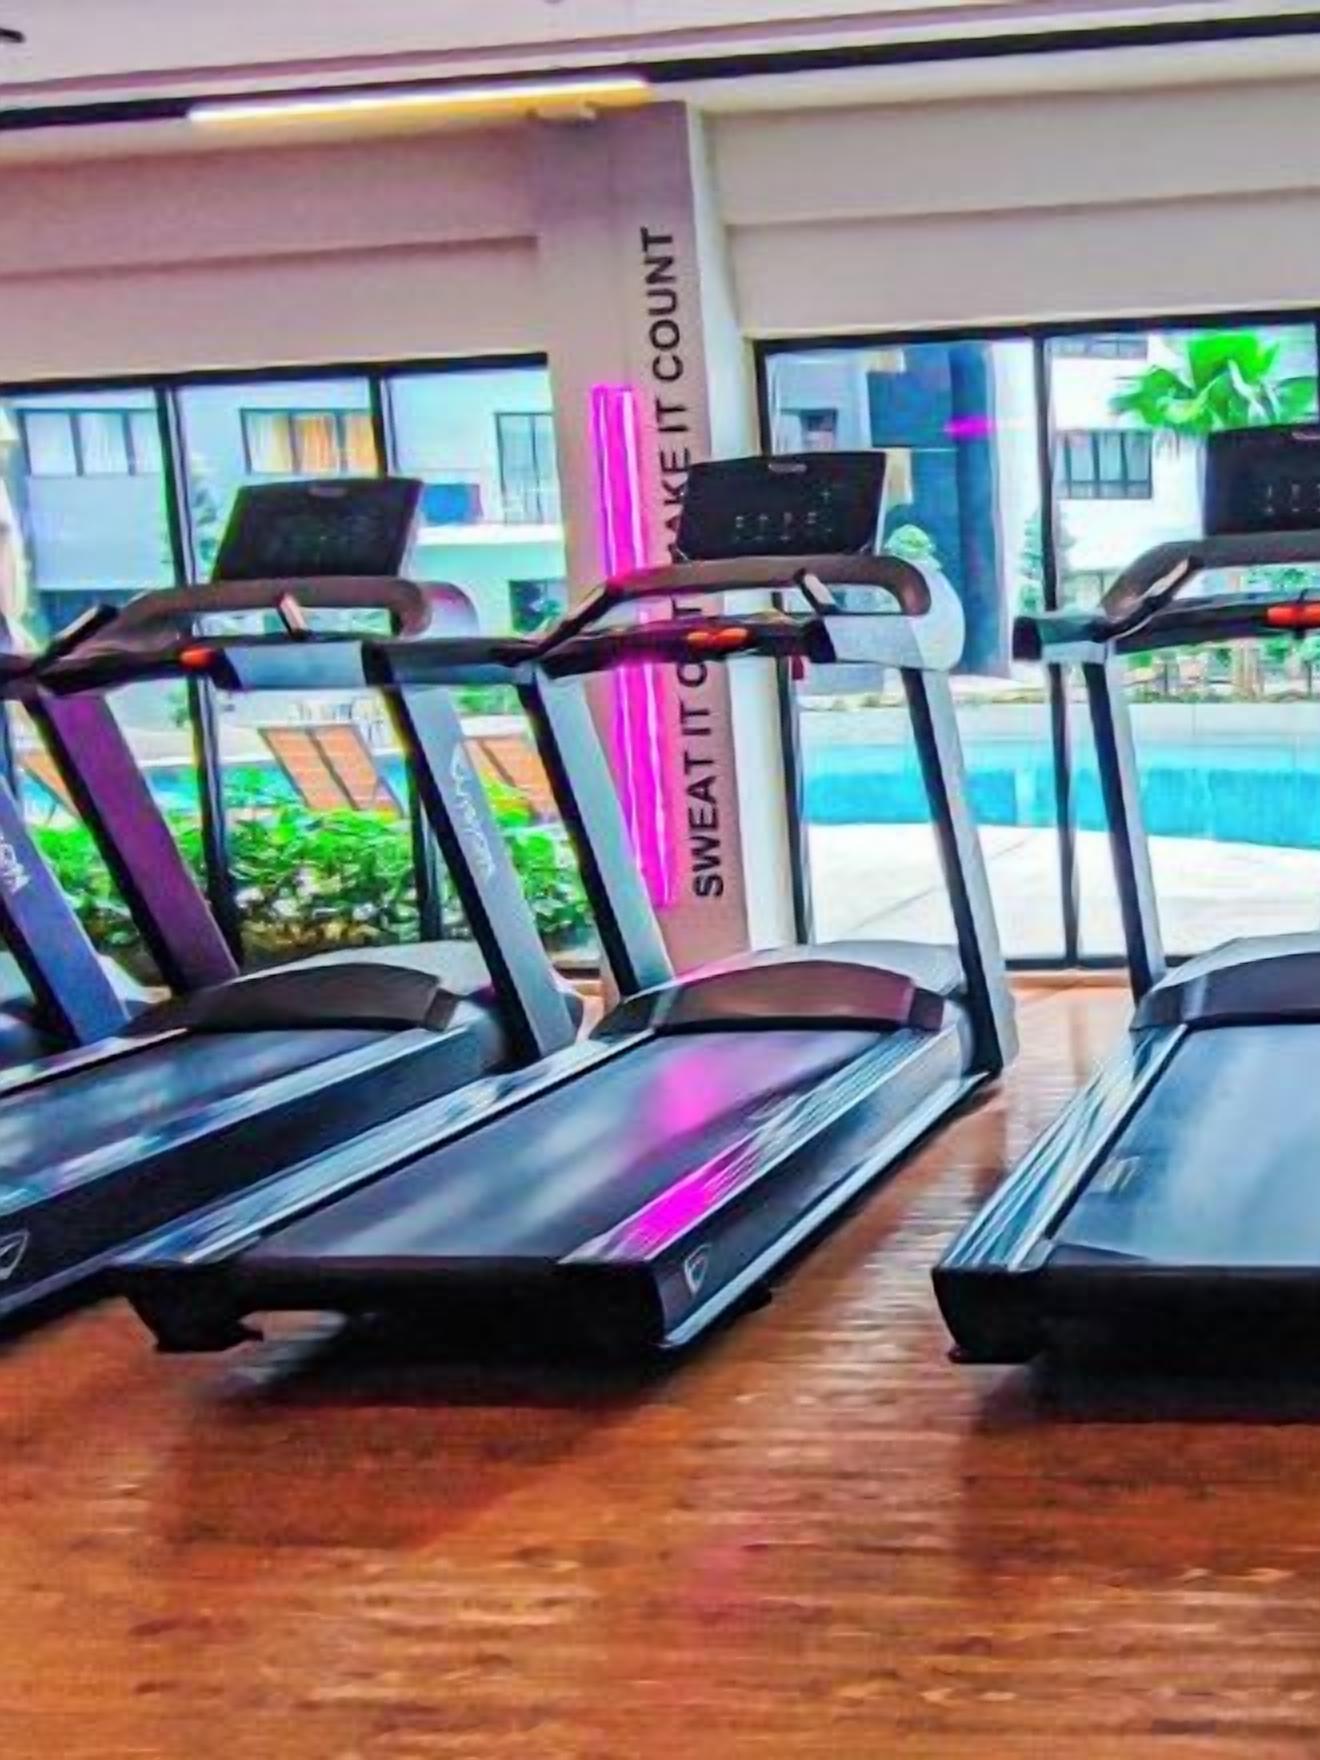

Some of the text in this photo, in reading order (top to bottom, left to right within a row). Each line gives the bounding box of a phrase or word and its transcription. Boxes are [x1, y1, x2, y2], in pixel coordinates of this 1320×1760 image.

[640, 226, 684, 382] COUNT
[656, 396, 689, 432] IT
[671, 597, 708, 687] OT
[680, 697, 711, 735] IT
[684, 751, 724, 897] SWEAT
